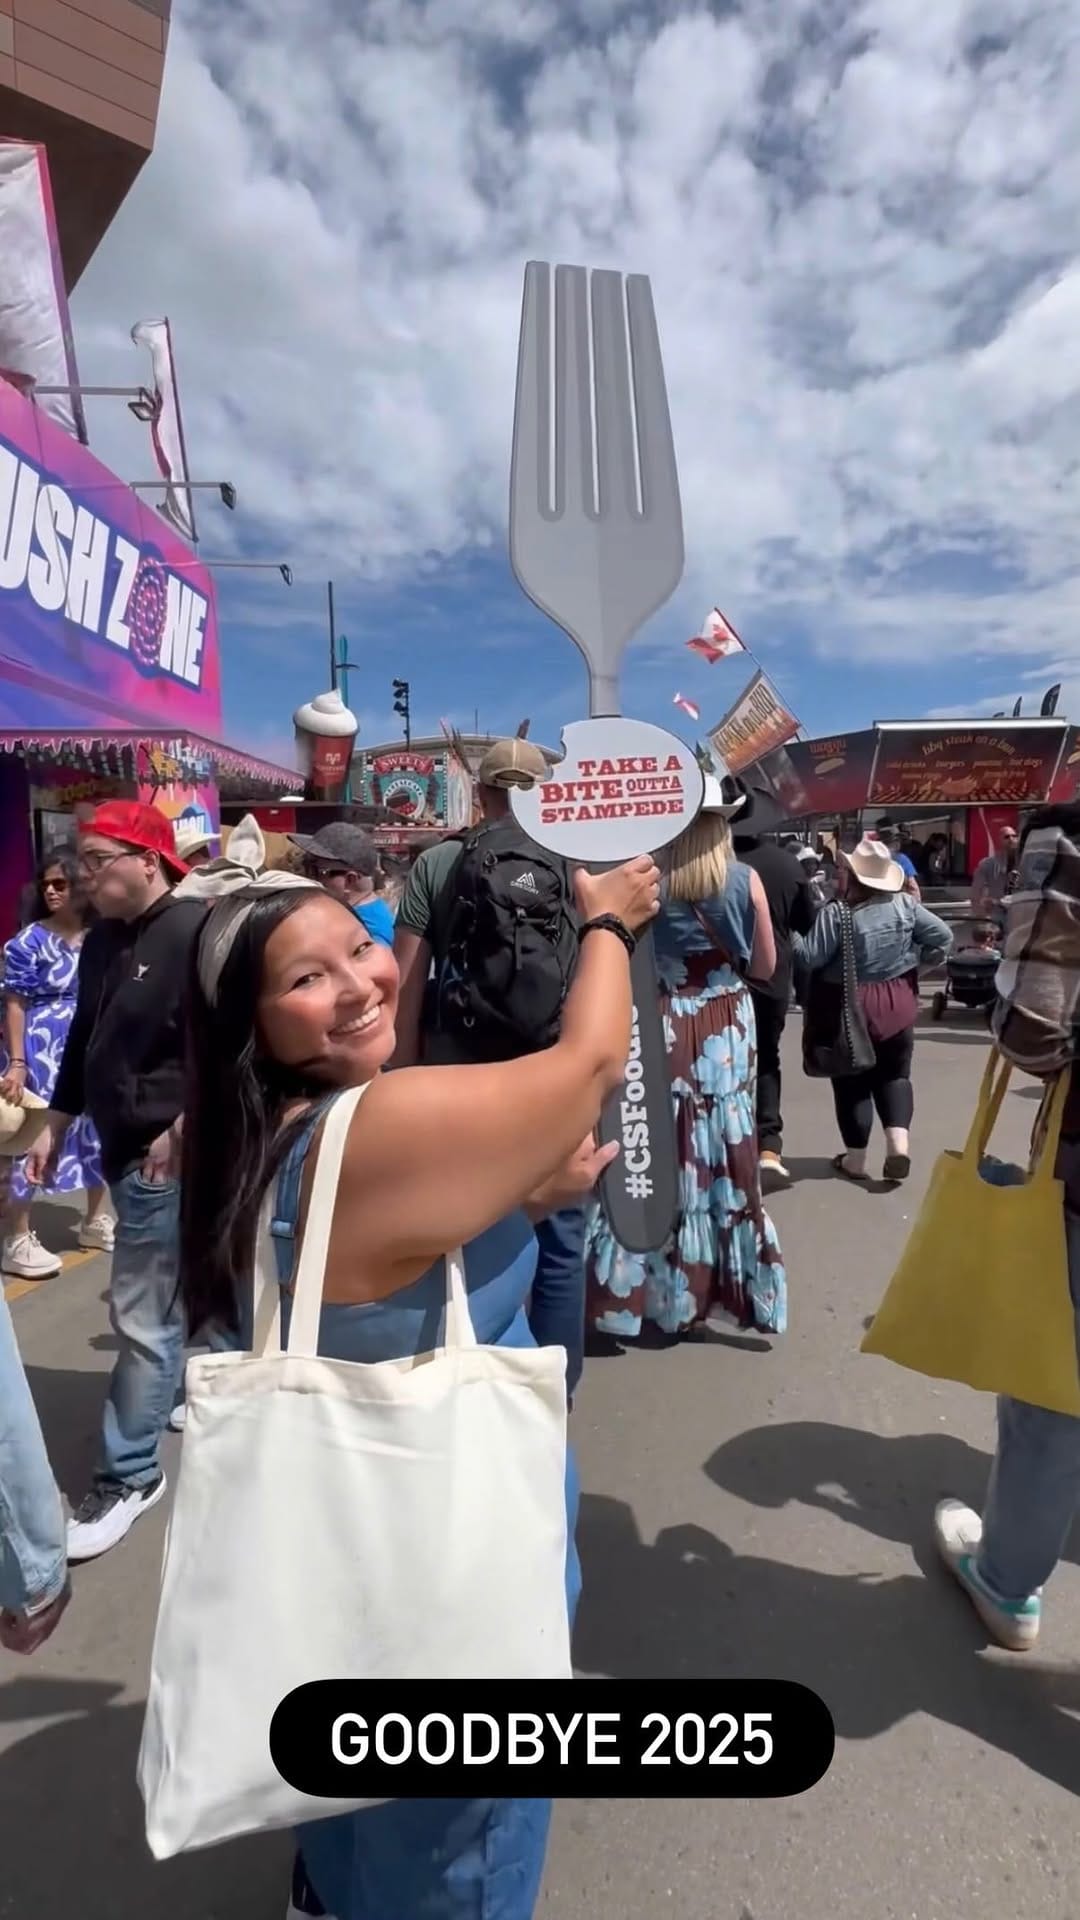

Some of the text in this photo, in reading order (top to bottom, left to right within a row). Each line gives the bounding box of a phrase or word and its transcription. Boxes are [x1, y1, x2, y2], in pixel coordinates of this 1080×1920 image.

[105, 535, 208, 687] ZONE
[577, 755, 683, 777] TAKE A
[540, 776, 682, 804] BITE OUTTA
[541, 799, 684, 824] STAMPEDE
